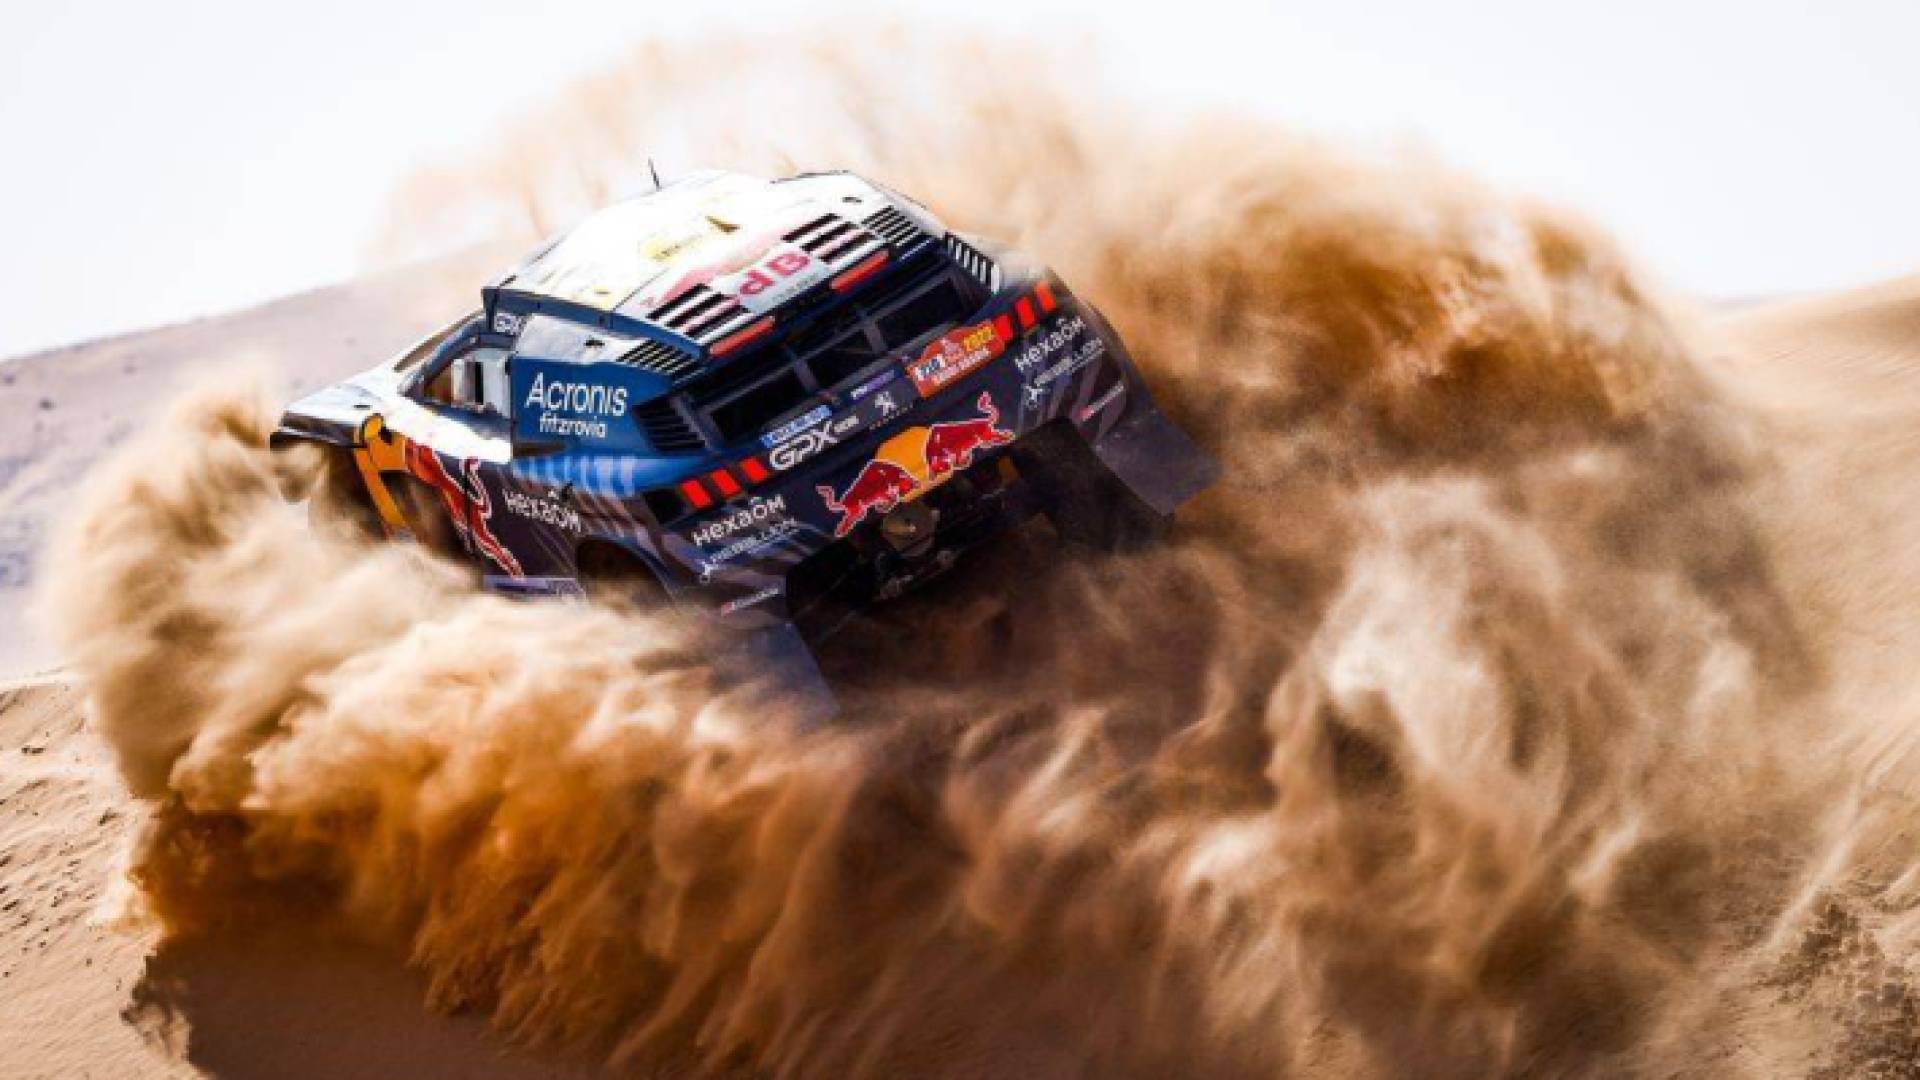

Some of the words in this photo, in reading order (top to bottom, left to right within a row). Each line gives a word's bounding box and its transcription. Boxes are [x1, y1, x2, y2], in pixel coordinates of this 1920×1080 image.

[524, 371, 628, 417] Acronis
[539, 412, 607, 438] fitzrovia
[769, 421, 839, 471] GPX
